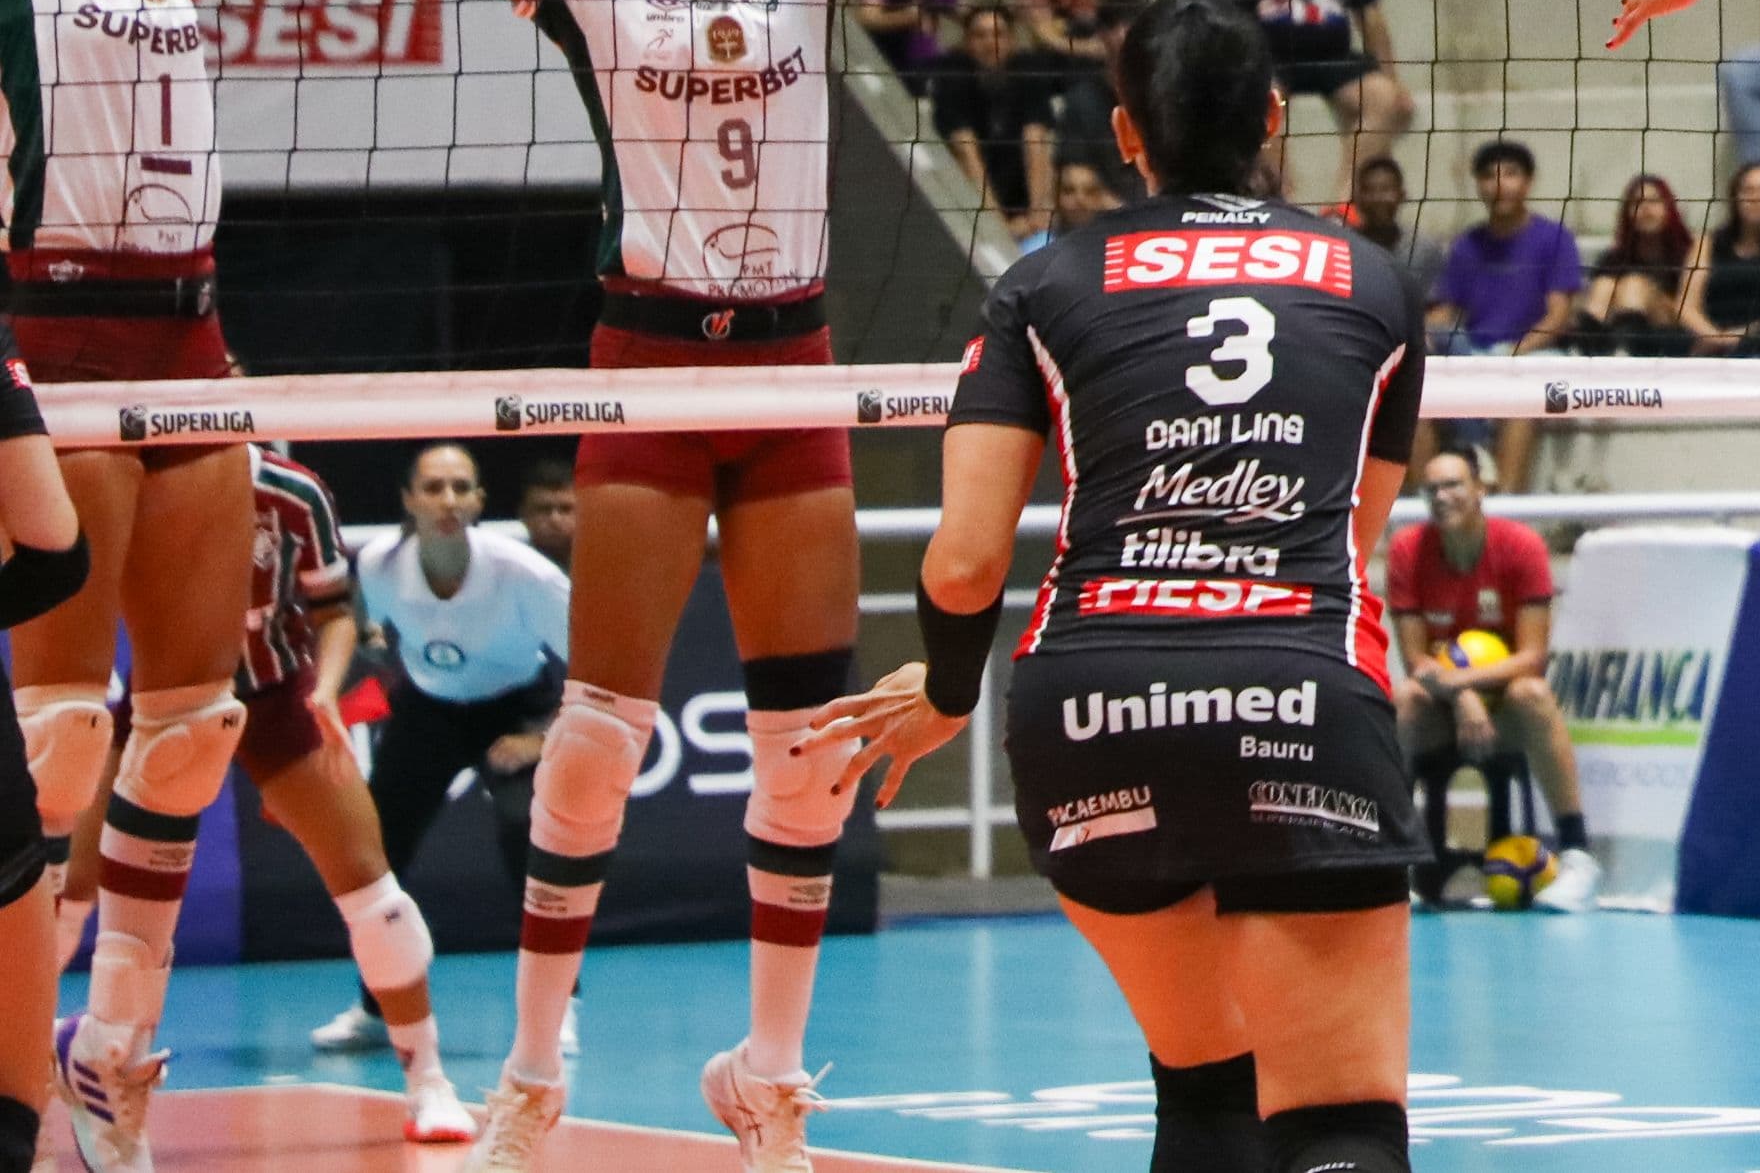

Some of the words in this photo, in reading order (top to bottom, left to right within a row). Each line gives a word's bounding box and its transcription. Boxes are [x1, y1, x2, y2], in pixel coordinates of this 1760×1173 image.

[72, 3, 199, 56] SUPERB
[634, 45, 807, 106] SUPERBET
[717, 117, 757, 191] 9
[1180, 211, 1272, 225] PENALTY
[1126, 236, 1330, 285] SESI
[1185, 296, 1277, 407] 3
[150, 410, 255, 437] SUPERLIGA
[524, 401, 626, 426] SUPERLIGA
[1571, 388, 1664, 410] SUPERLIGA
[1134, 458, 1306, 523] Medley
[1120, 529, 1281, 577] tilibra
[1062, 680, 1318, 743] Unimed
[1239, 735, 1315, 763] Bauru
